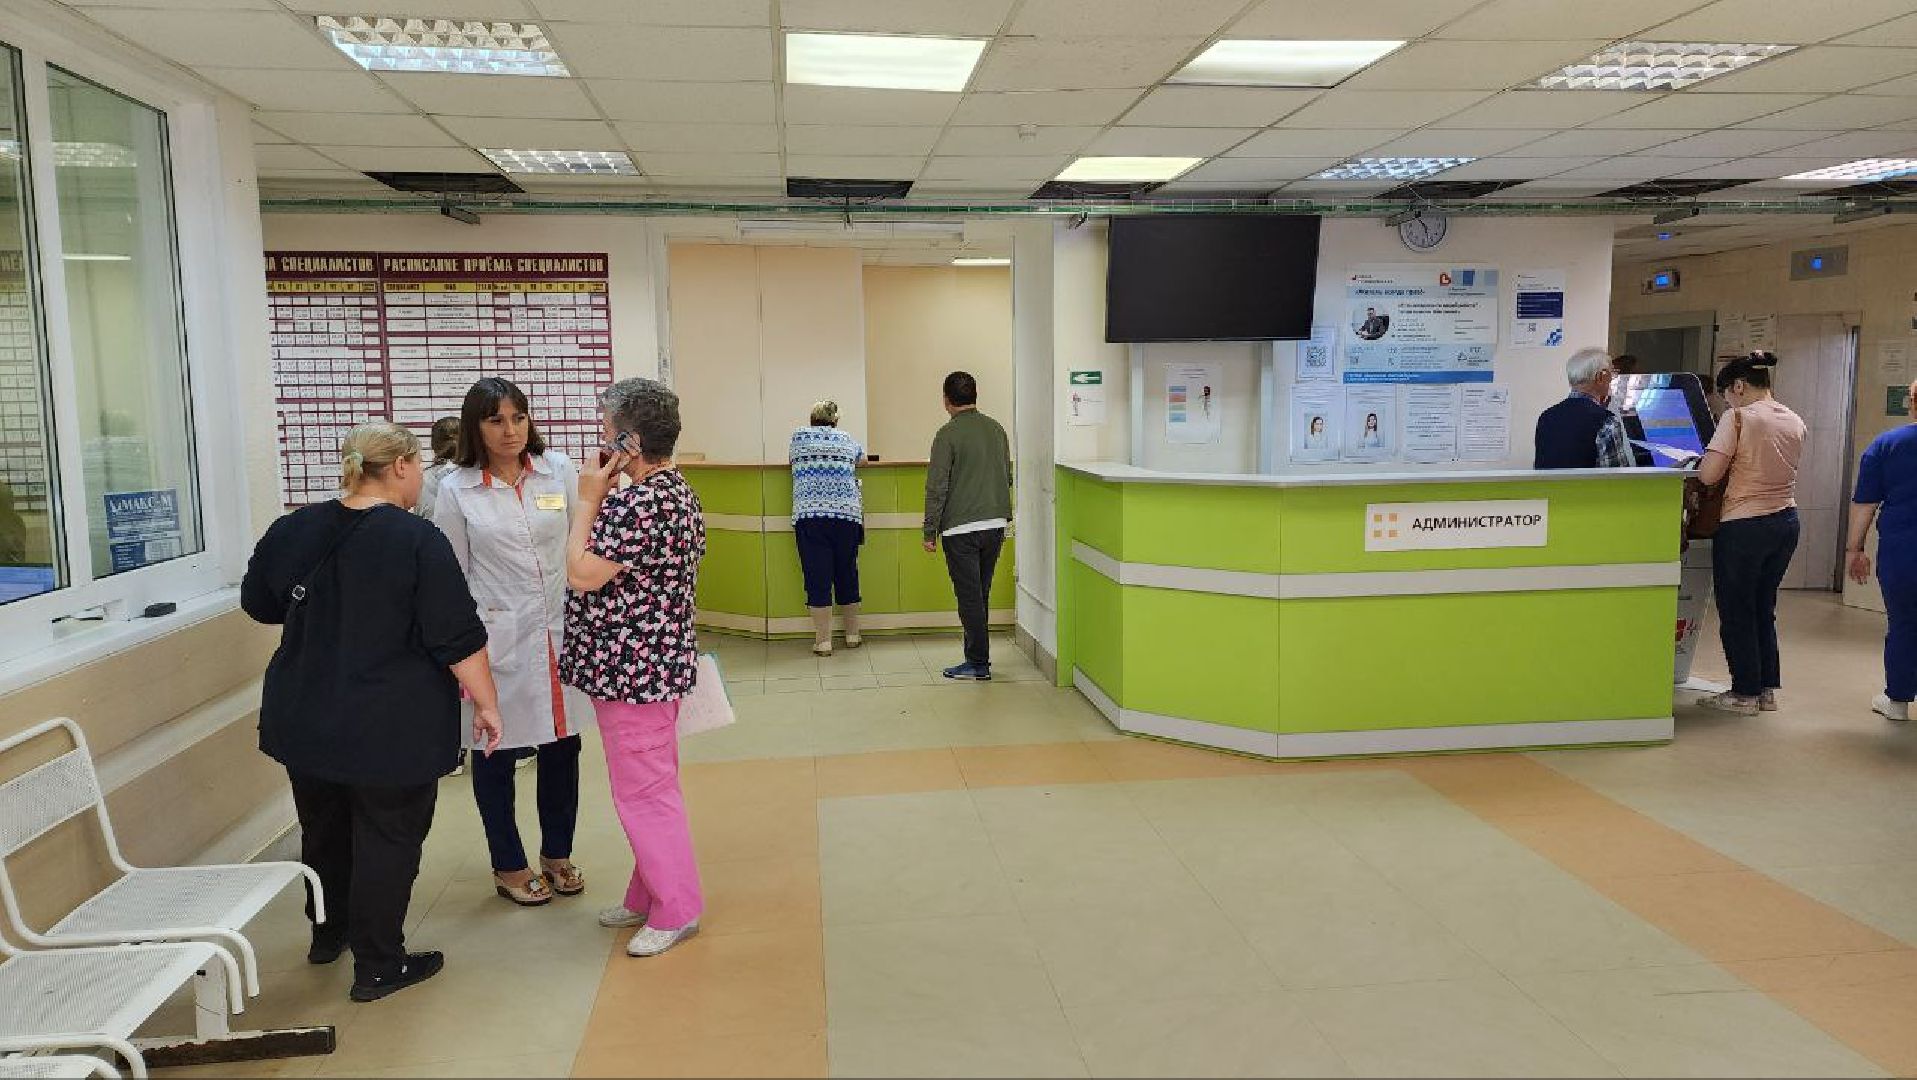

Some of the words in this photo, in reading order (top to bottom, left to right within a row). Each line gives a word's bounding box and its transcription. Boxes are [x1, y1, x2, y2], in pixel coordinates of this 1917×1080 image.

[282, 256, 373, 272] СПЕЦИАЛИСТОВ
[383, 258, 459, 272] РАСПИСАНИЕ
[464, 256, 513, 272] ПРИЁМА
[517, 258, 604, 274] СПЕЦИАЛИСТОВ
[1412, 514, 1542, 531] АДМИНИСТРАТОР
